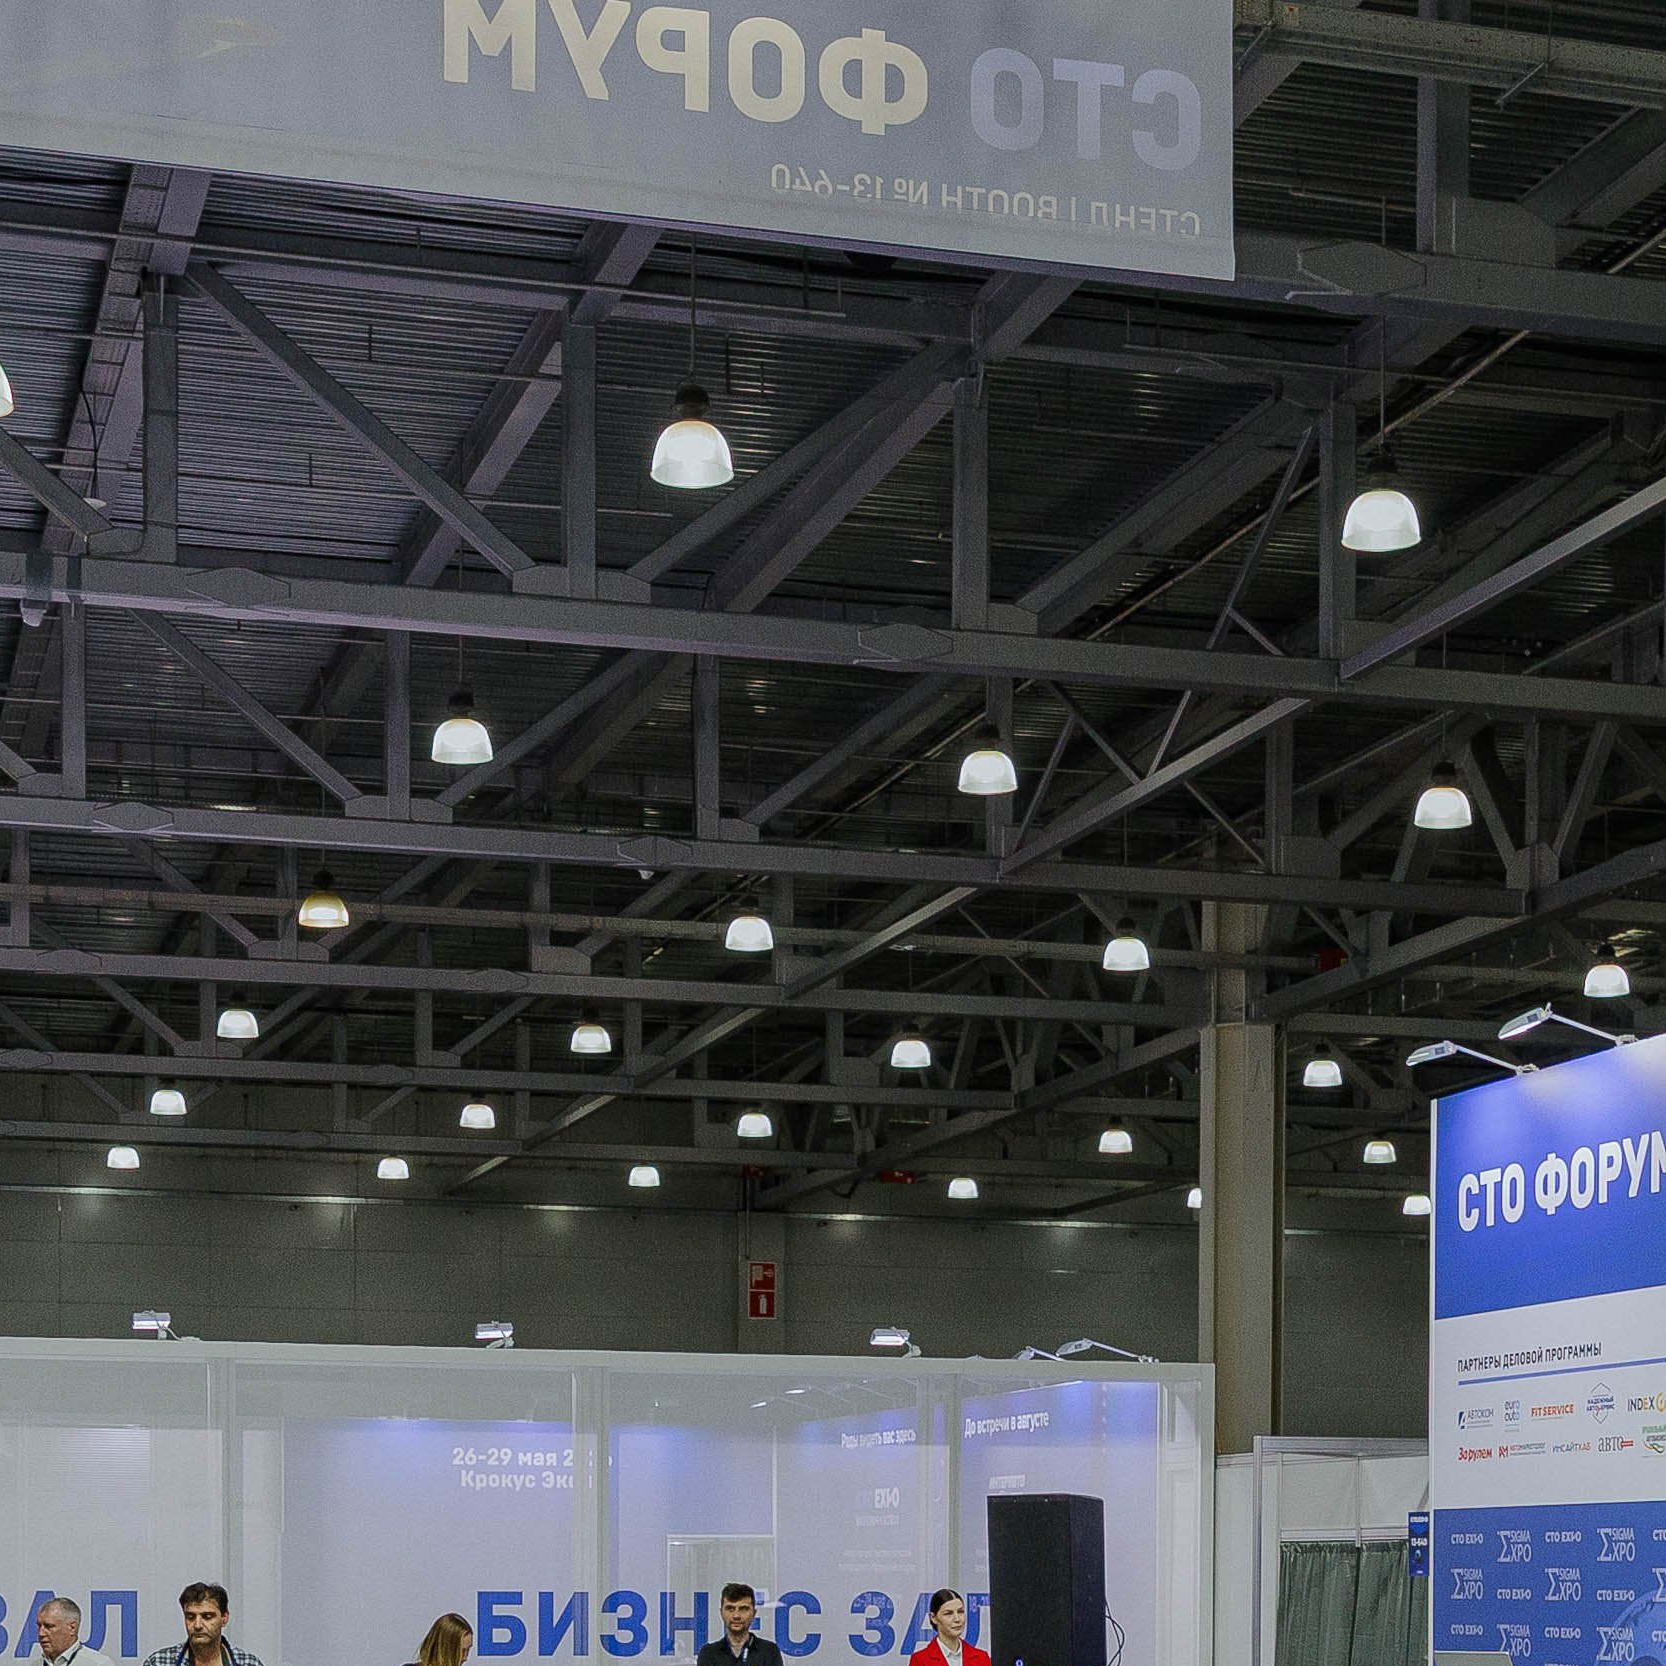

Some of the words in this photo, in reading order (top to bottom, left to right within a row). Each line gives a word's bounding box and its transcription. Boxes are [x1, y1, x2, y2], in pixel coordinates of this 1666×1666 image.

[1458, 1162, 1525, 1233] СТО
[1457, 1355, 1502, 1373] ПАРТНЕРЫ
[1502, 1346, 1543, 1369] ДЕЛОВОЙ
[1544, 1341, 1602, 1362] ПРОГРАММЫ
[1627, 1396, 1655, 1412] INDEX
[452, 1447, 513, 1466] 26-29
[518, 1451, 558, 1466] мая
[460, 1469, 536, 1492] Крокус
